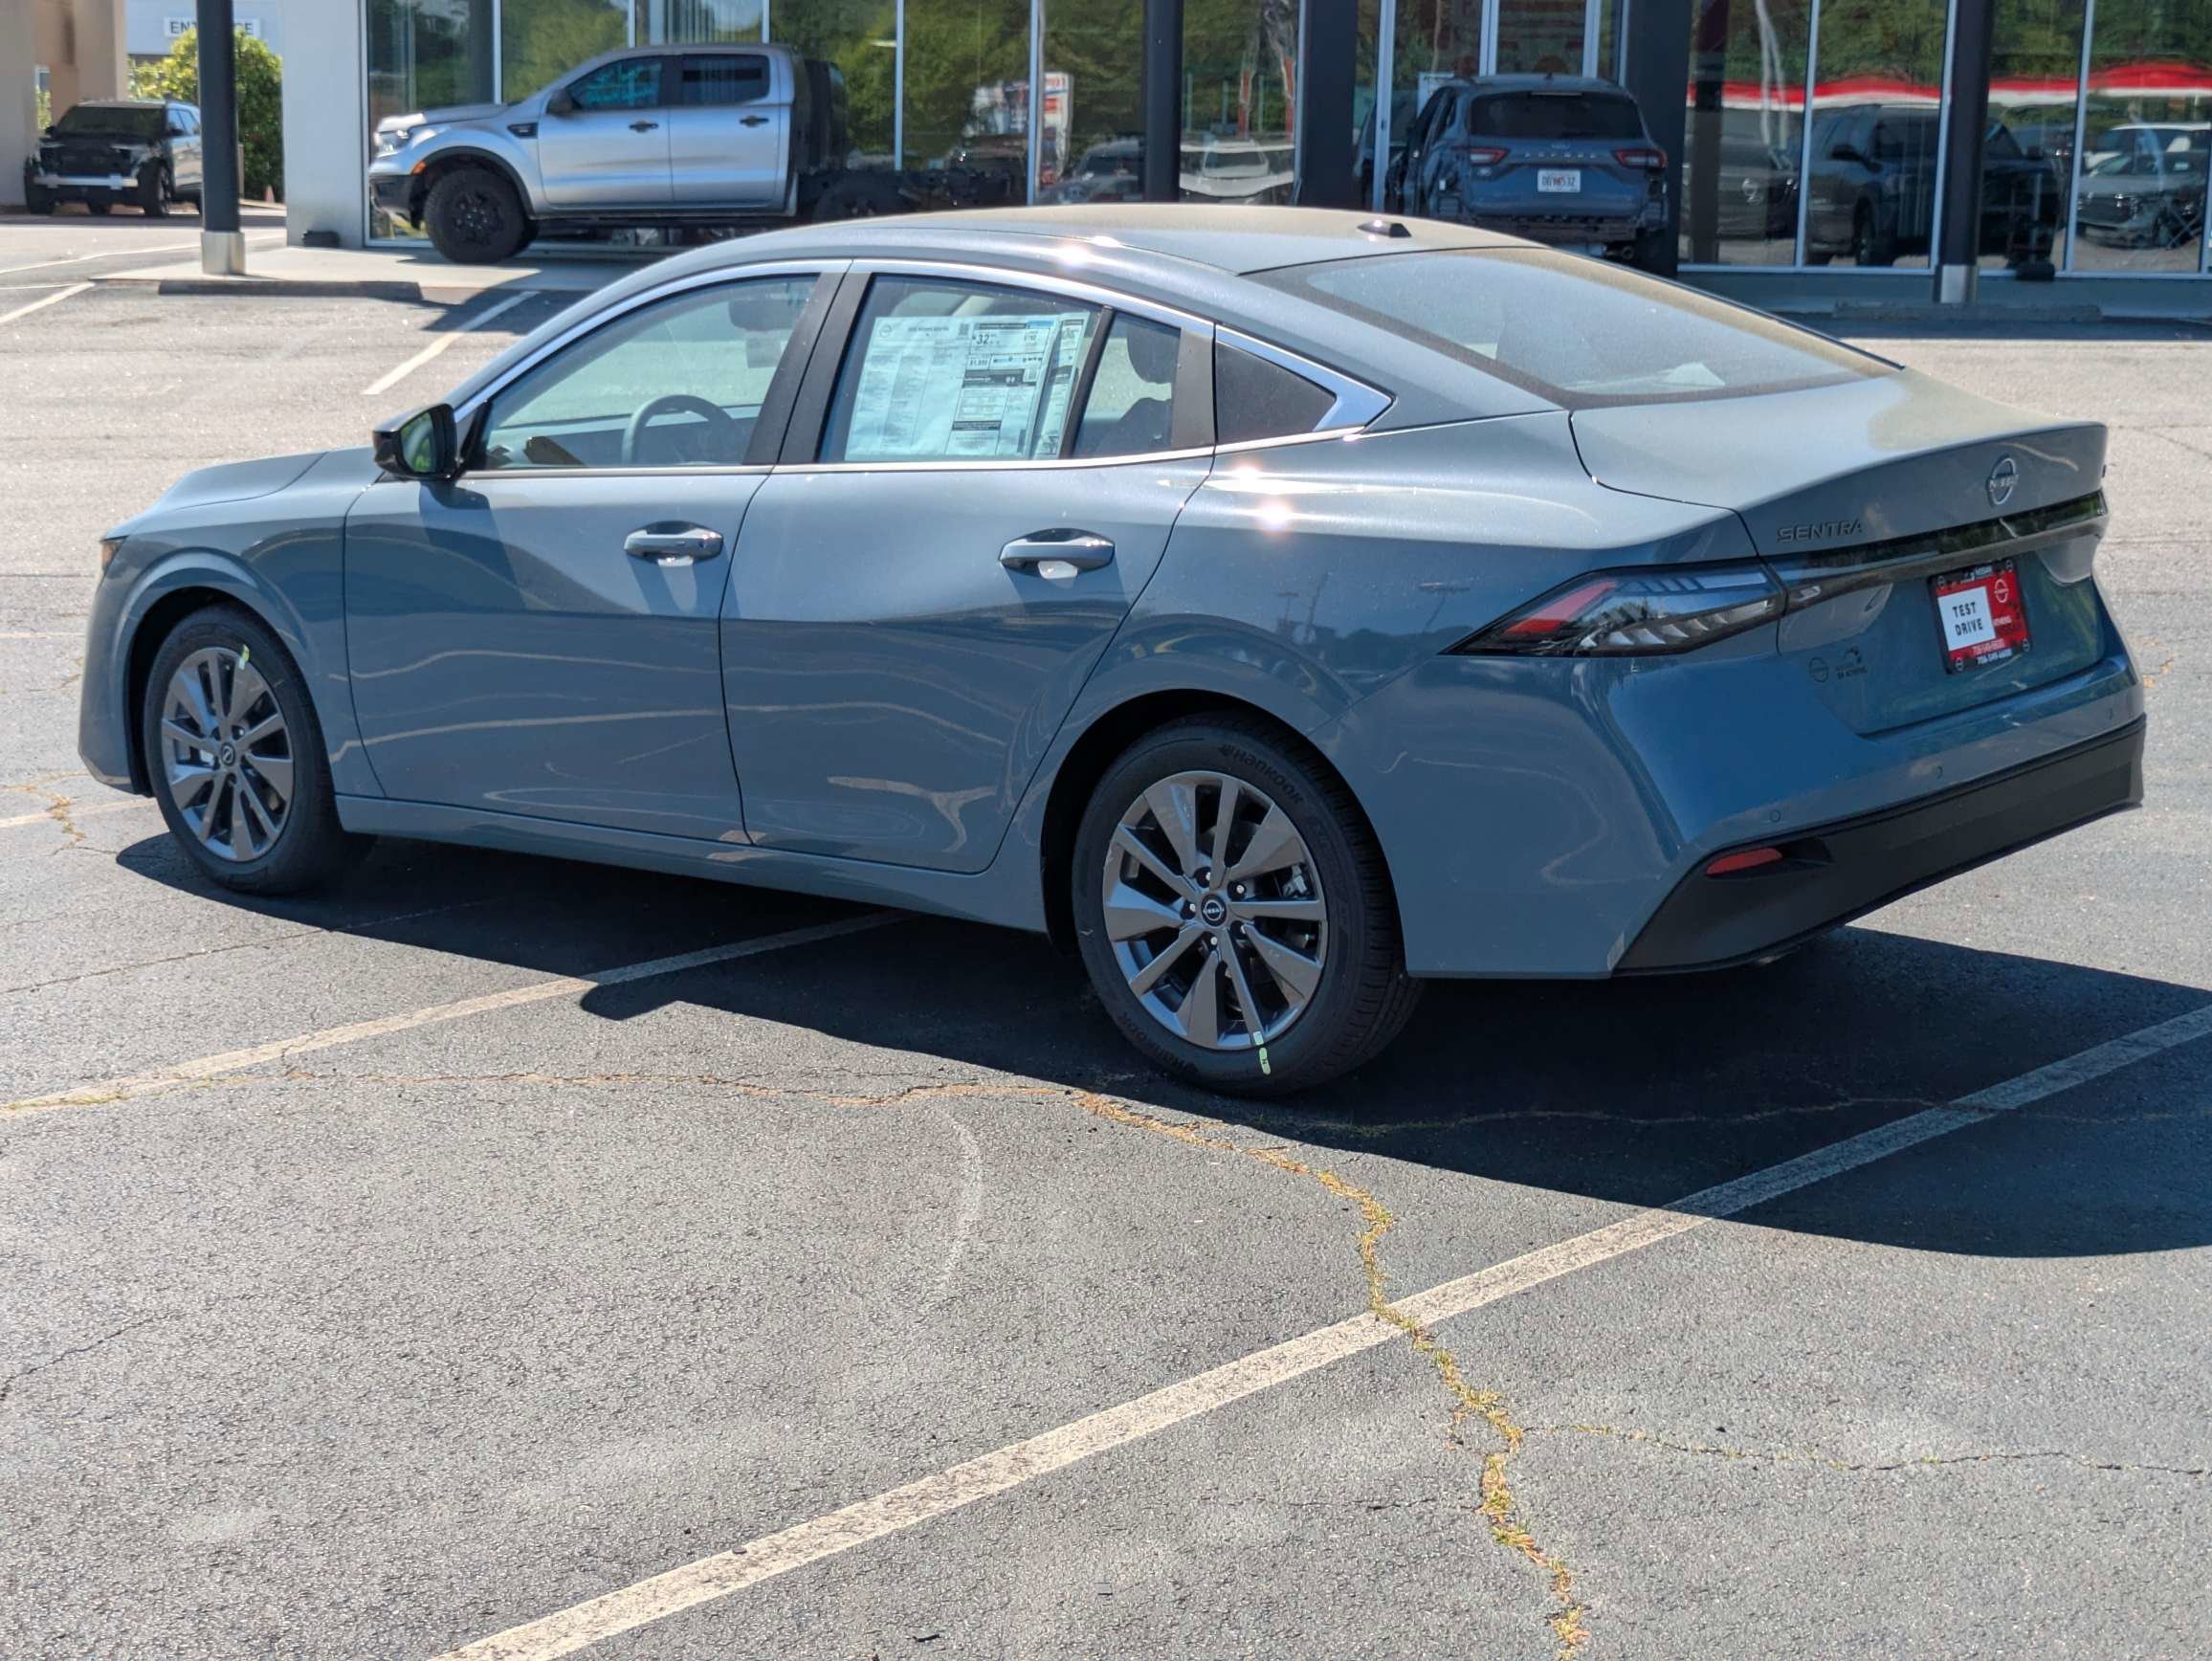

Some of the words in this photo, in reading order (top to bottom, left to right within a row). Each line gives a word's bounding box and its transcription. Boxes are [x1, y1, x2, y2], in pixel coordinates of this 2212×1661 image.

[1777, 518, 1863, 543] SENTRA
[1952, 601, 1977, 618] TEST
[1955, 618, 1983, 636] DRIVE
